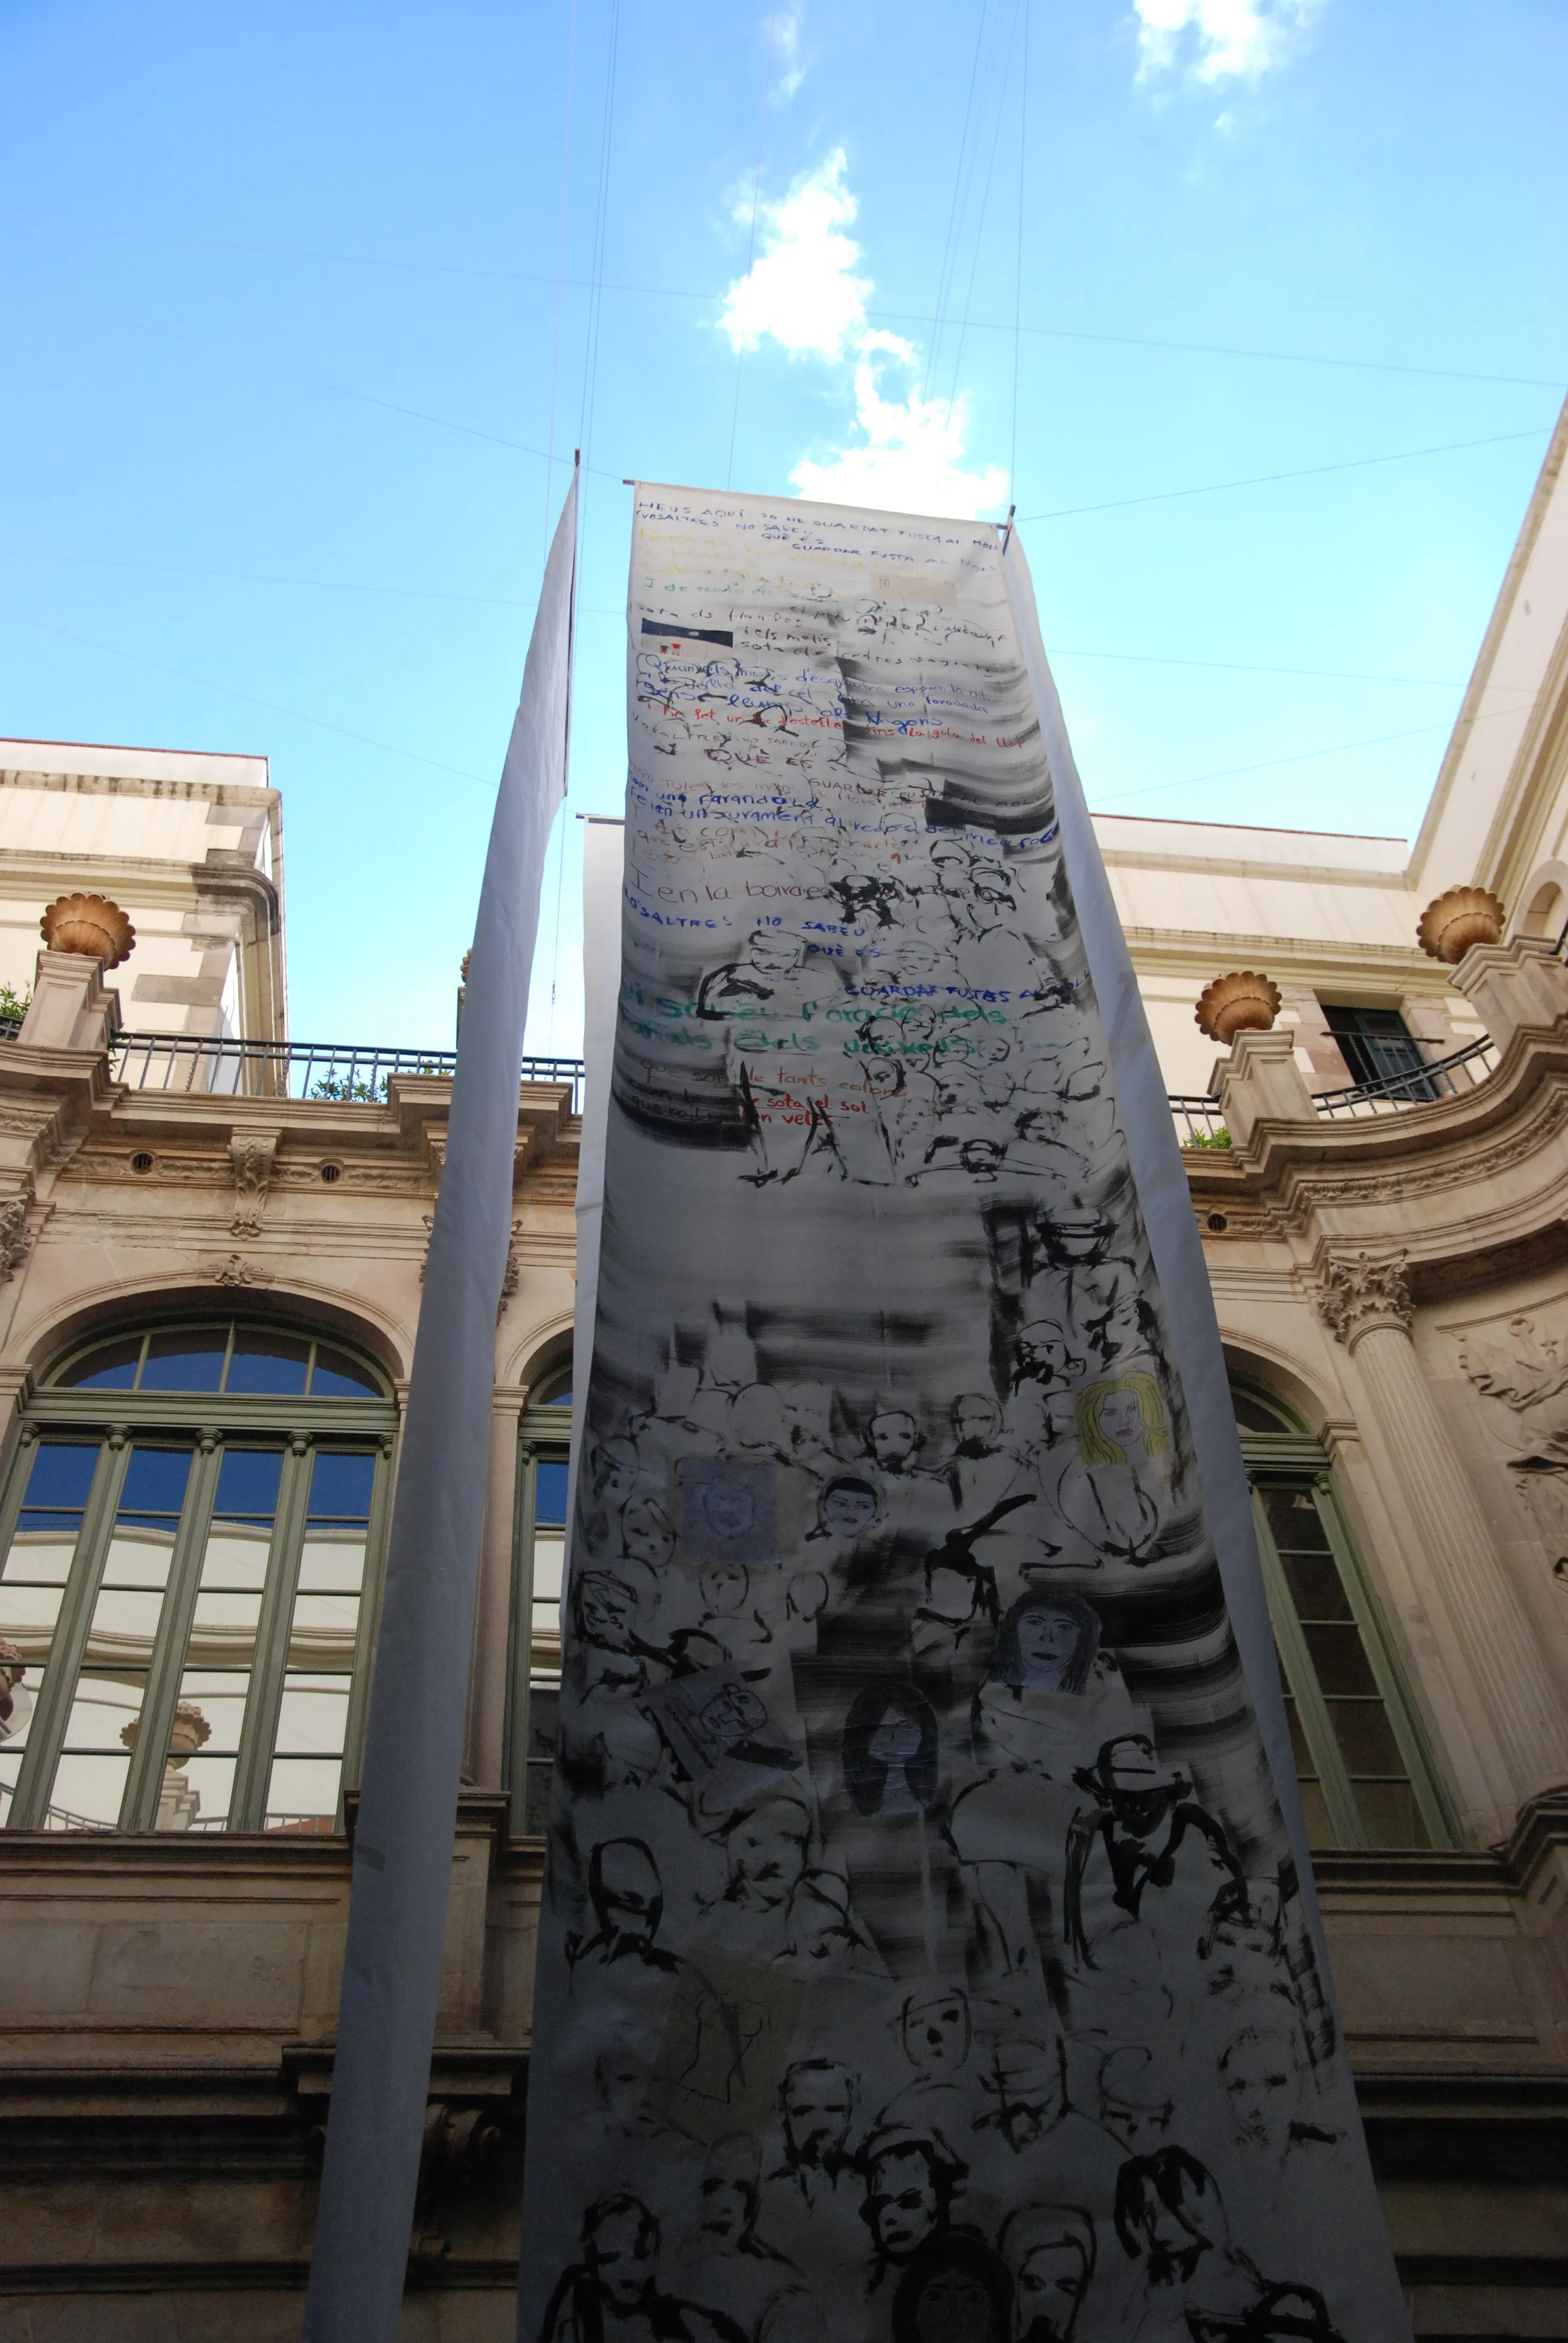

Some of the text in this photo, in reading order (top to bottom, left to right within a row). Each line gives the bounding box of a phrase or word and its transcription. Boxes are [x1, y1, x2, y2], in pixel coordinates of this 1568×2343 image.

[639, 502, 691, 513] HEUS
[814, 520, 889, 534] GUARDAT
[792, 543, 862, 555] GUARDAR
[870, 549, 915, 562] FUSTA
[755, 628, 777, 640] els
[741, 641, 785, 652] sota
[750, 684, 781, 693] del
[789, 687, 812, 700] cel
[887, 700, 915, 709] una
[950, 683, 964, 695] la
[909, 727, 925, 737] la
[932, 728, 962, 739] gola
[971, 732, 987, 745] del
[996, 737, 1025, 749] llop
[682, 808, 707, 819] un
[658, 886, 697, 903] en
[705, 885, 734, 901] la
[745, 880, 802, 898] boira
[757, 916, 782, 926] NO
[802, 921, 865, 937] SABEU
[806, 944, 844, 957] QUÈ
[777, 1066, 826, 1087] tants
[766, 1092, 805, 1109] sota
[815, 1093, 829, 1109] el
[841, 1101, 867, 1113] sol
